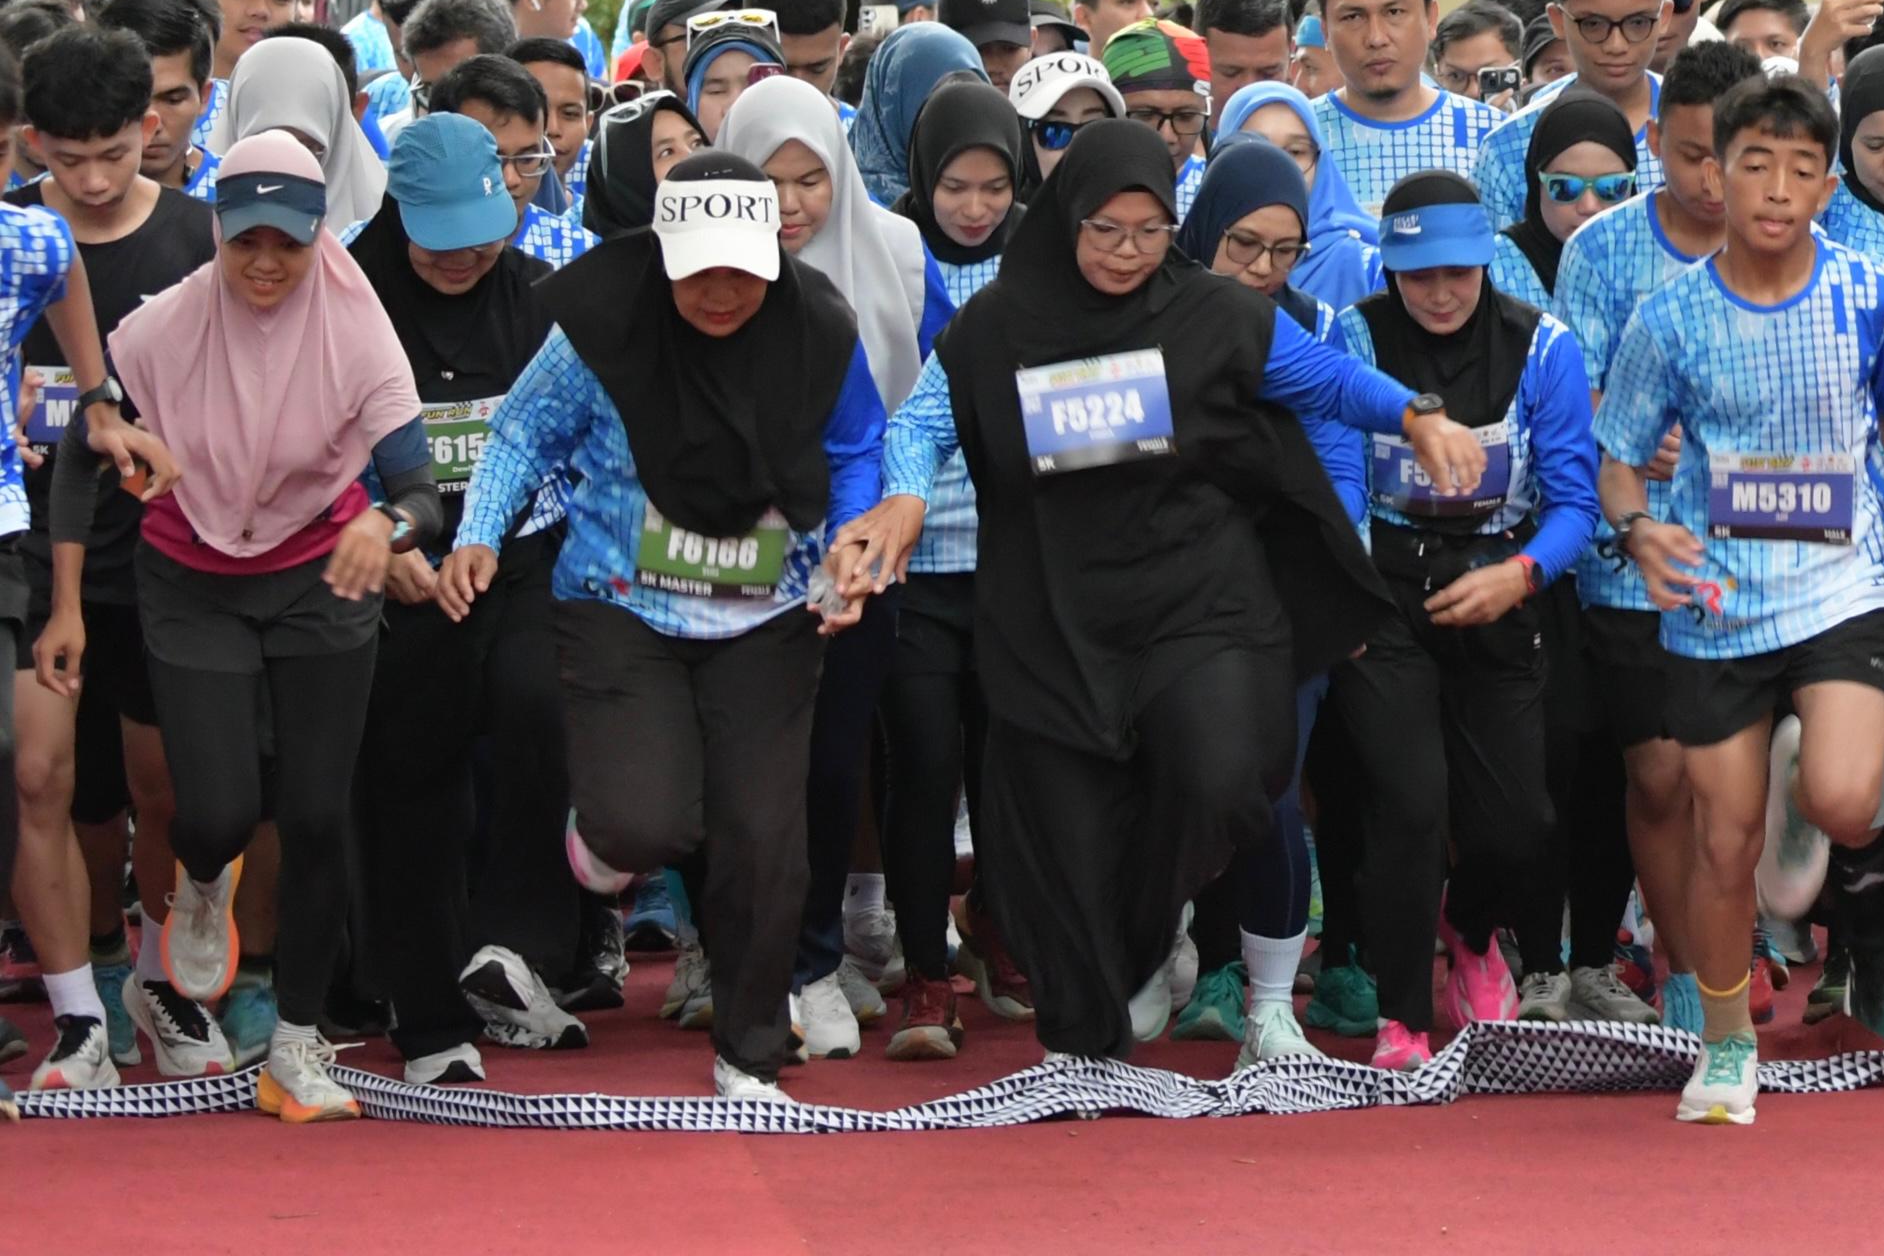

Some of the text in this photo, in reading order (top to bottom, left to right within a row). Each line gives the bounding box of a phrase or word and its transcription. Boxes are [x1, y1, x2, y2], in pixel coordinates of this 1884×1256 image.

[661, 193, 773, 223] SPORT
[1051, 388, 1145, 436] F5224
[33, 445, 49, 455] 5K
[1732, 481, 1832, 513] M5310
